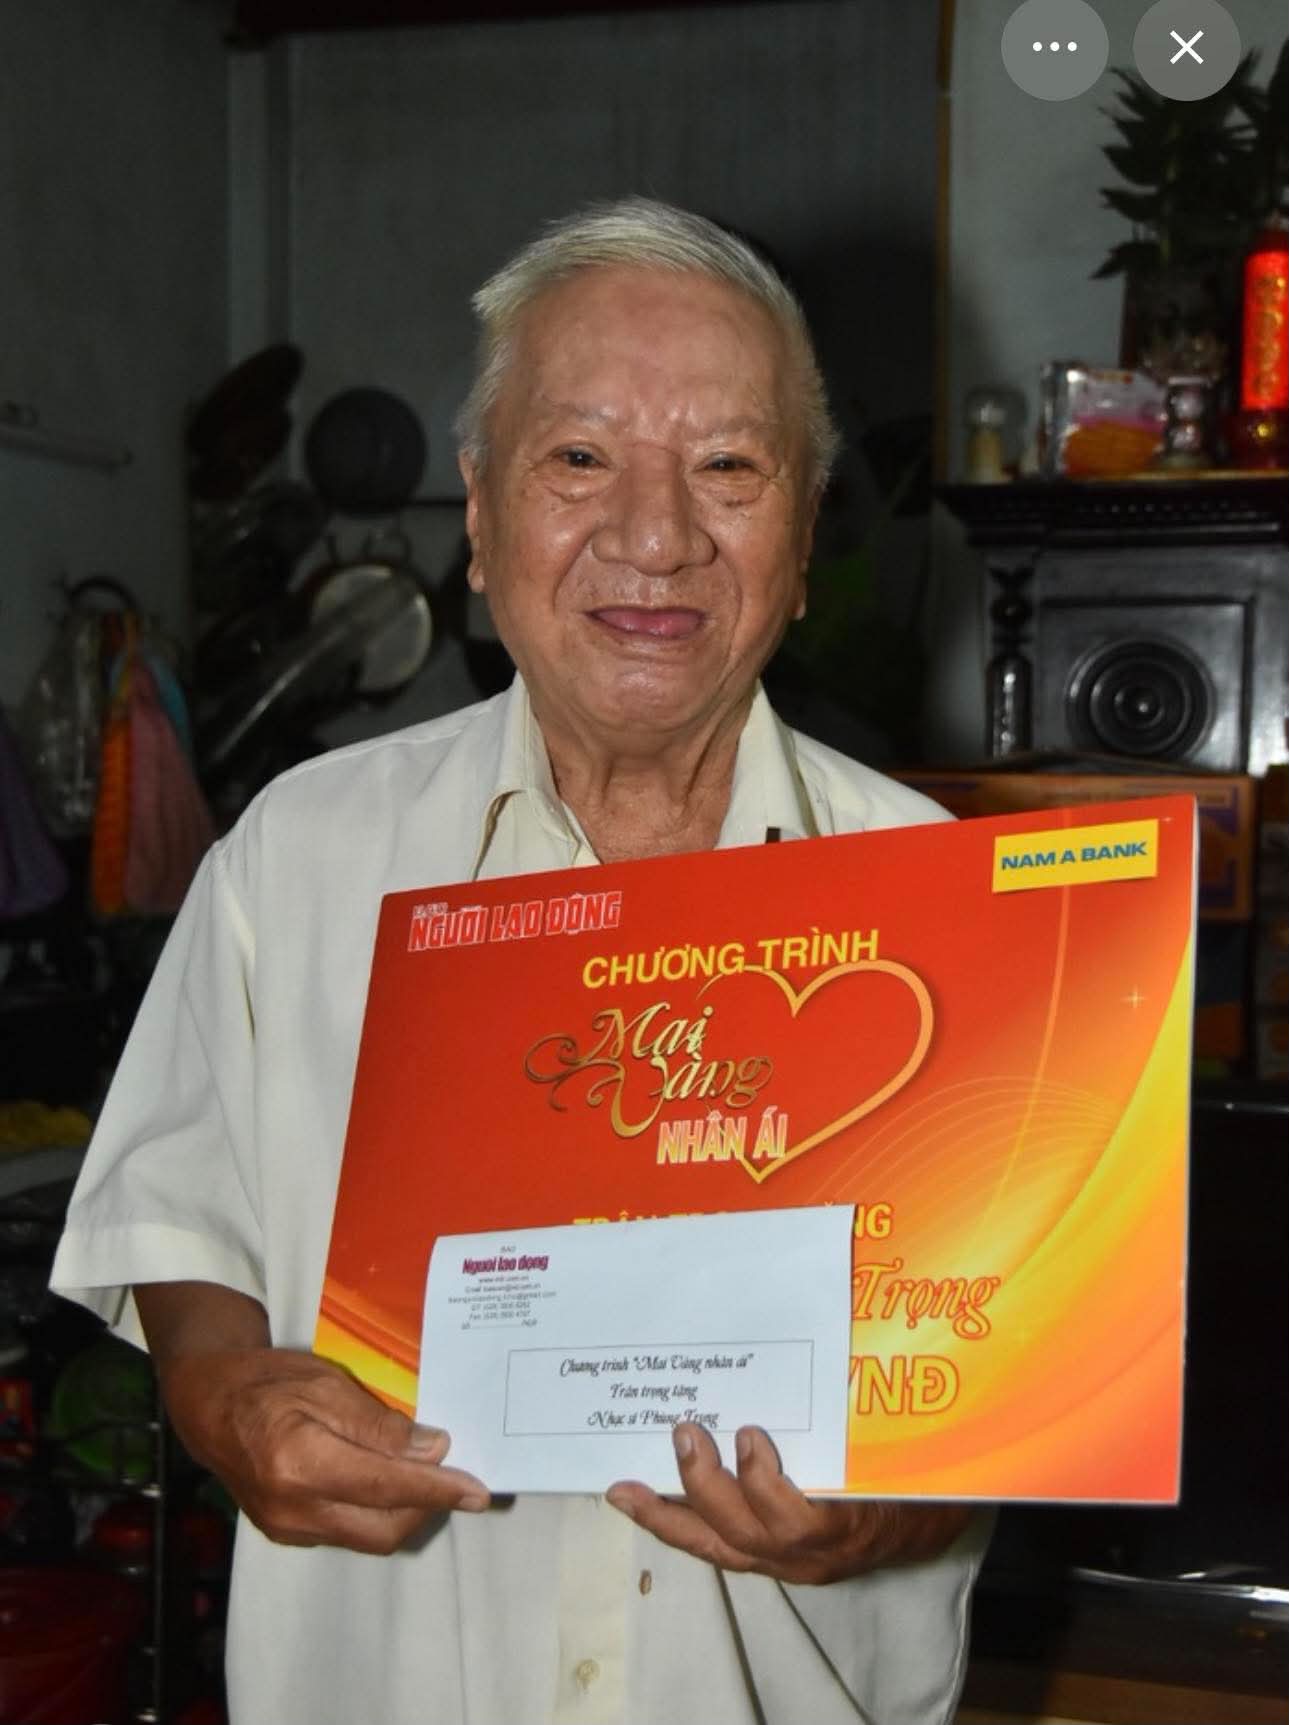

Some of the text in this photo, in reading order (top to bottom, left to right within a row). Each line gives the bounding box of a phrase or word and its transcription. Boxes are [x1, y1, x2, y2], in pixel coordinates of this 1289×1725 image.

[1001, 841, 1147, 870] NAM A BANK
[488, 901, 544, 942] LAO
[582, 927, 879, 988] CHƯƠNG TRÌNH
[558, 1002, 714, 1066] Mai
[656, 1105, 788, 1164] NHÂN ÁI
[852, 1257, 1001, 1340] Trọng
[849, 1355, 960, 1415] NĐ
